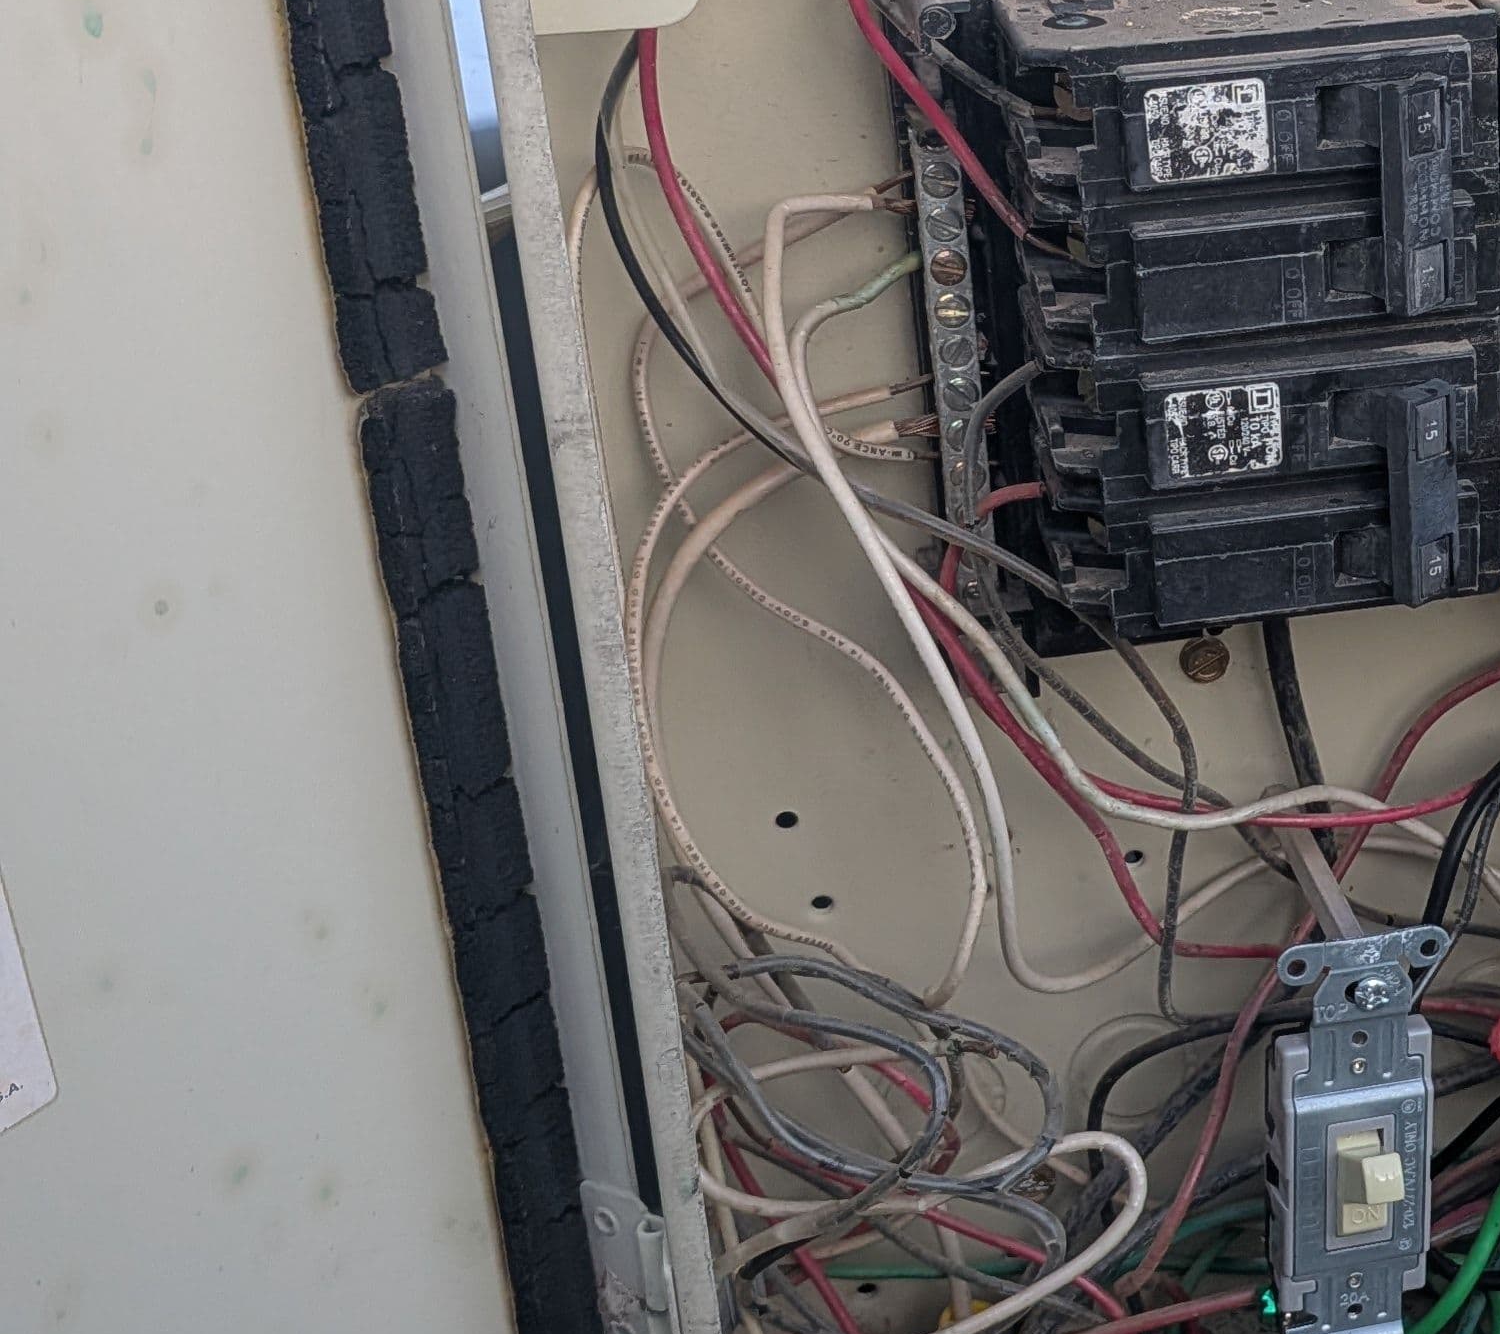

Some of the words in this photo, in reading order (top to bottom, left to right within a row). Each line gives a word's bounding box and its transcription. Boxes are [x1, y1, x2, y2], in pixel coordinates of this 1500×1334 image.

[1417, 111, 1431, 134] 15
[1425, 420, 1438, 440] 15
[1429, 556, 1442, 576] 15
[1404, 1121, 1418, 1153] ONLY
[1352, 1204, 1381, 1225] ON
